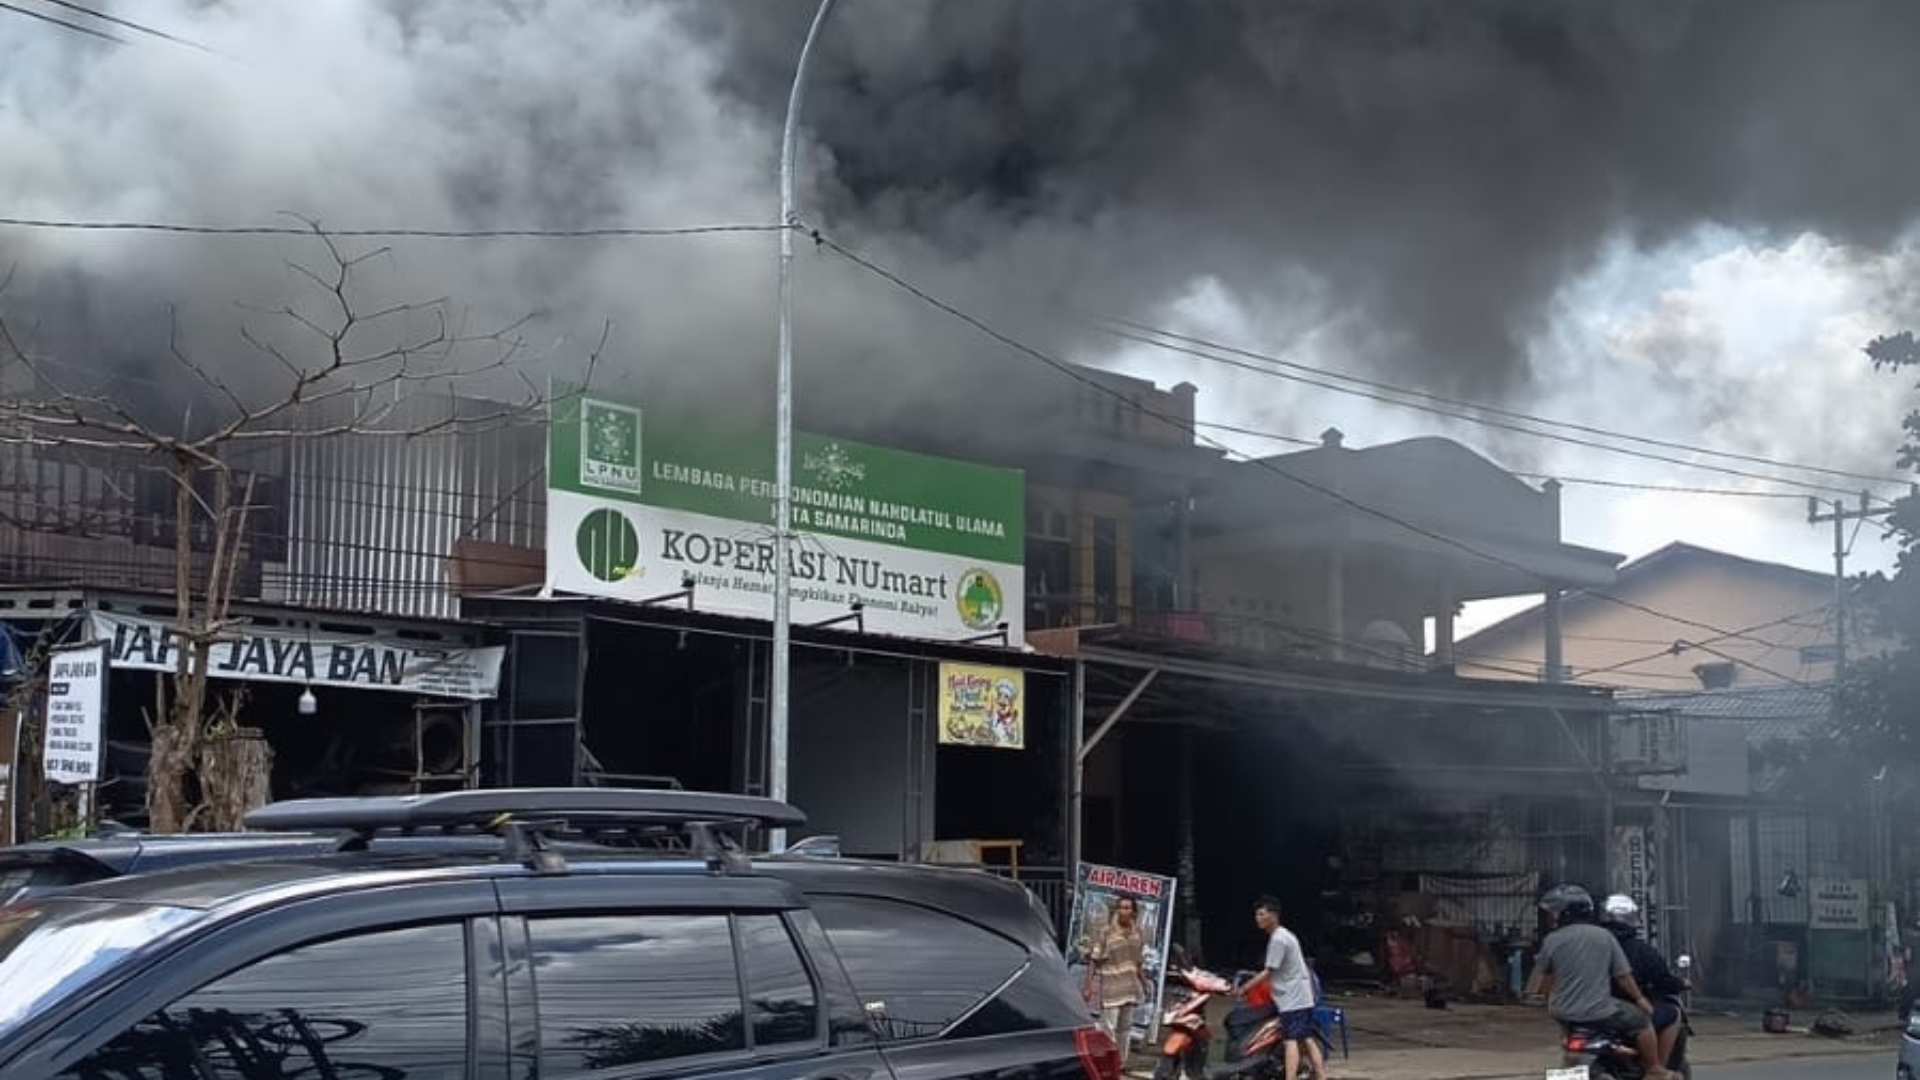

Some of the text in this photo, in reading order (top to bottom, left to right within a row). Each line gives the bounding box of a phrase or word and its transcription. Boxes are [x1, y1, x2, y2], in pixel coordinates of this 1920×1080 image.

[653, 461, 735, 492] LEMBAGA
[956, 519, 1005, 537] ULAMA
[815, 510, 906, 540] SAMARINDA
[837, 556, 947, 599] NUmart
[217, 635, 315, 679] JAYA
[328, 644, 406, 685] BAN
[1090, 870, 1117, 888] AIR
